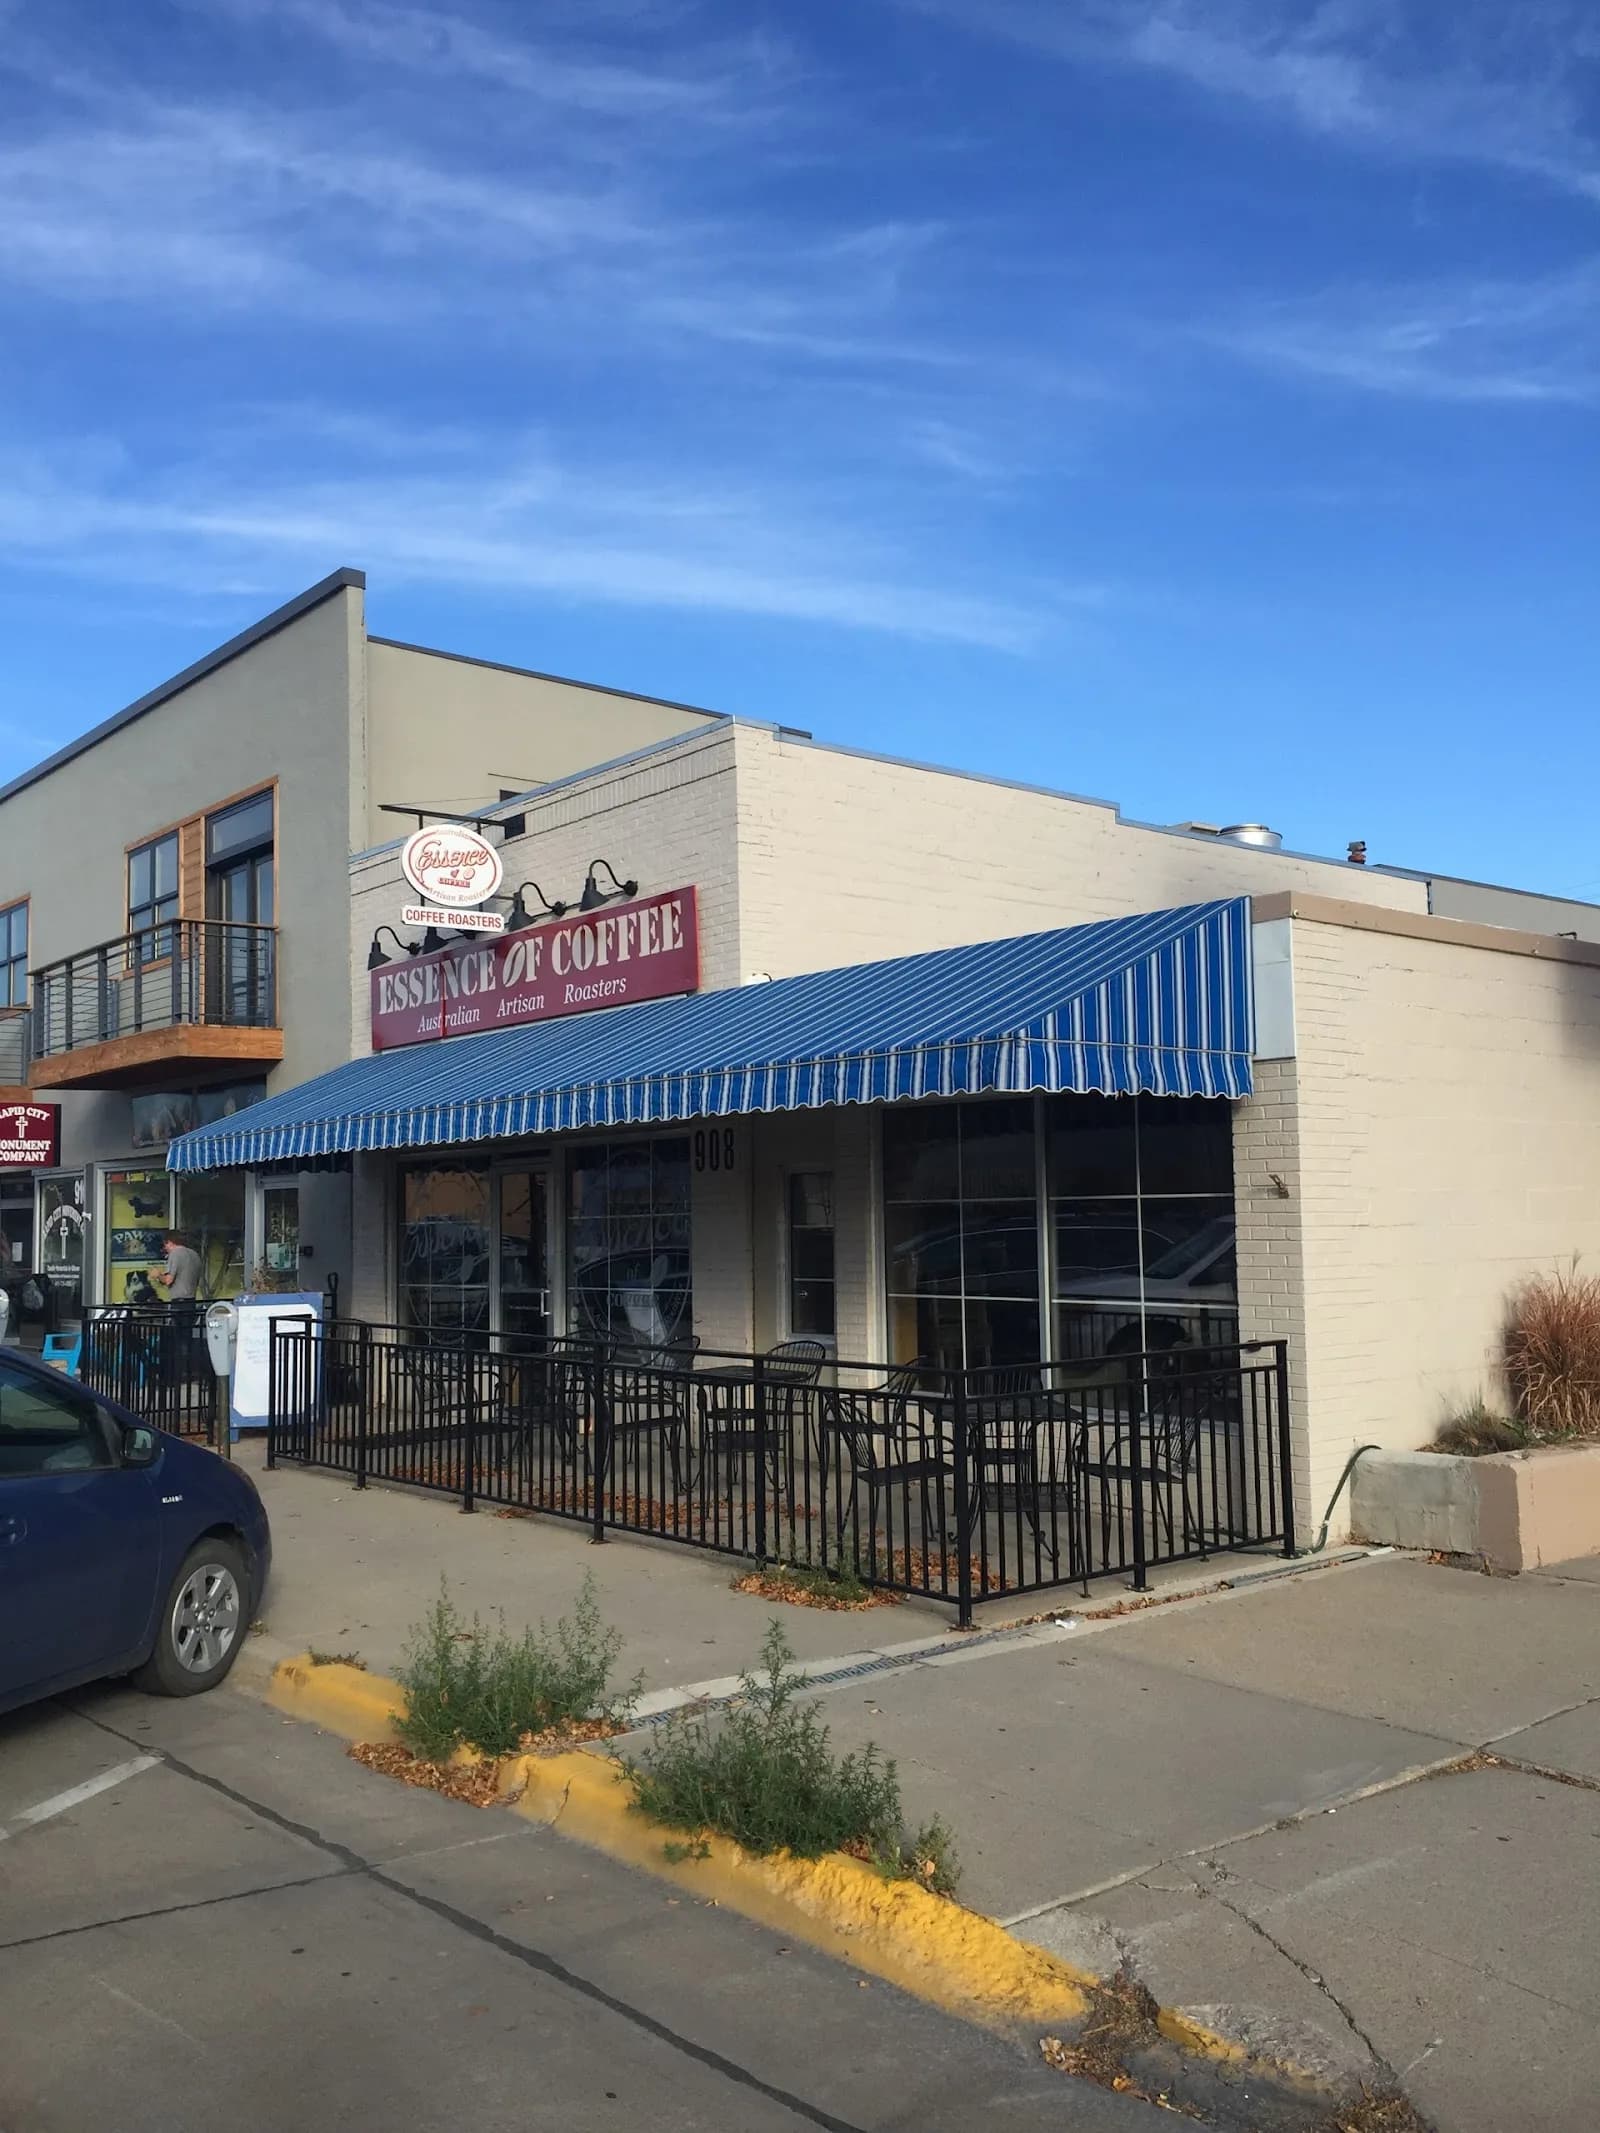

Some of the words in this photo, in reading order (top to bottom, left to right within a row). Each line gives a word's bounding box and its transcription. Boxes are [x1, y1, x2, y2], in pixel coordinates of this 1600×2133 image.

[415, 840, 489, 873] Essence
[405, 909, 445, 924] COFFEE
[448, 913, 502, 928] ROASTERS
[379, 949, 496, 1015] ESSENCE
[503, 935, 544, 988] OF
[551, 900, 684, 976] COFFEE
[417, 1005, 480, 1033] Australian
[496, 994, 545, 1018] Artisan
[563, 977, 627, 1005] Roasters
[26, 1107, 50, 1121] CITY
[0, 1139, 51, 1150] ONUMENT
[695, 1128, 734, 1172] 908
